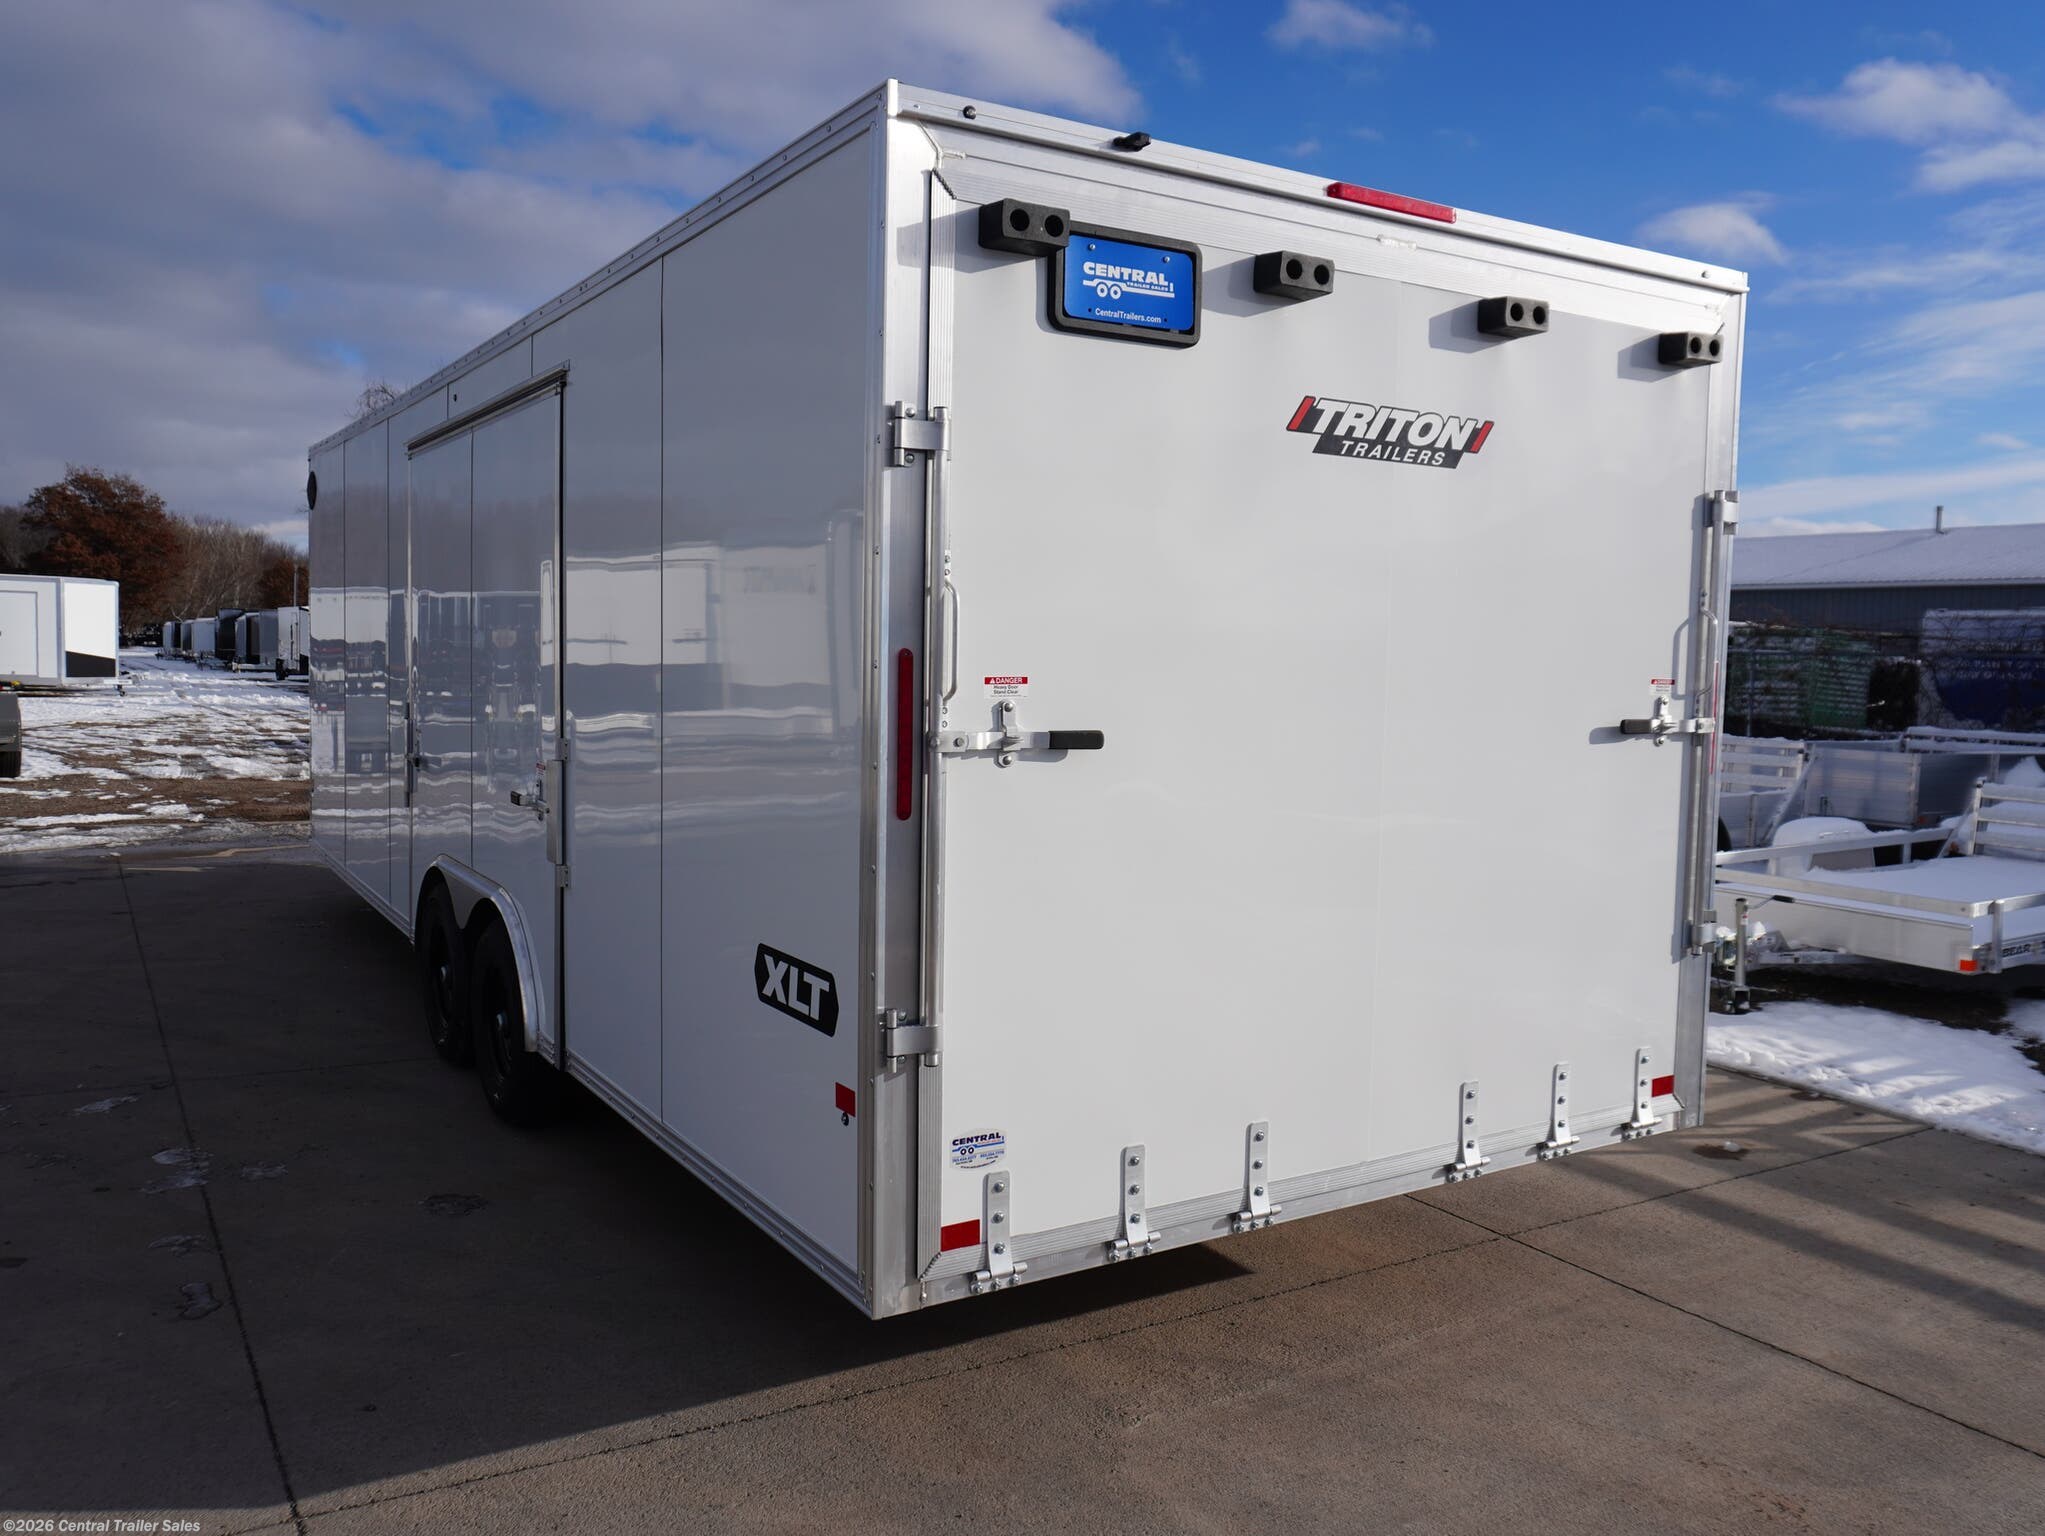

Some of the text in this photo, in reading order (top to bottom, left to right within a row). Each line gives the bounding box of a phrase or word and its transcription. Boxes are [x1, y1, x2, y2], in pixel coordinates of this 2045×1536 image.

[1083, 261, 1169, 286] CENTRAL
[1095, 307, 1162, 323] CentralTrailers.com
[1312, 398, 1478, 451] TRITON
[1340, 440, 1446, 466] TRAILERS
[761, 953, 830, 1021] XLT
[952, 1132, 1002, 1146] CENTRAL
